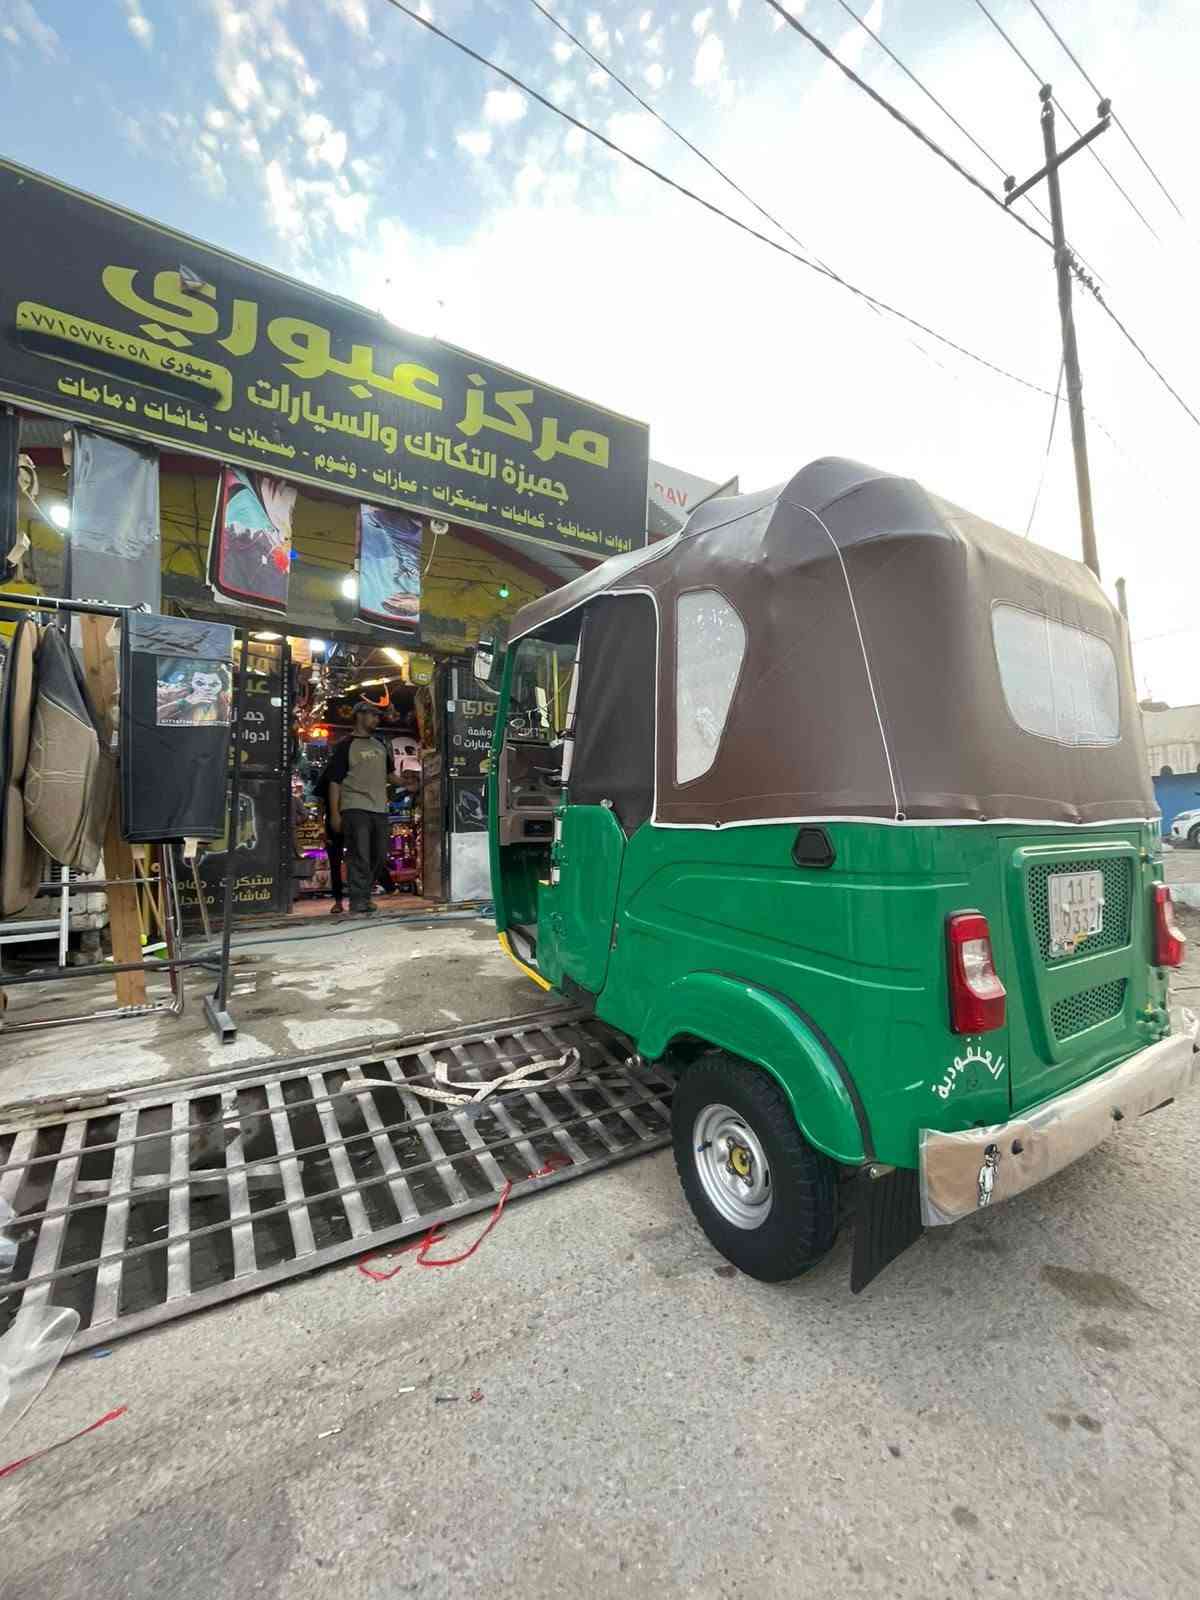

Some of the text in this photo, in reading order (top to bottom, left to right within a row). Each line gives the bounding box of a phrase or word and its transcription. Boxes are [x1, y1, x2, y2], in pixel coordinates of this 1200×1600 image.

[102, 265, 609, 468] مركز عبوري
[143, 401, 208, 432] شاشات
[247, 379, 398, 454] والسيارات
[228, 427, 296, 458] مسجلات
[404, 432, 496, 478] التكاتك
[372, 469, 417, 494] عبارات
[432, 485, 488, 512] ستيكرات
